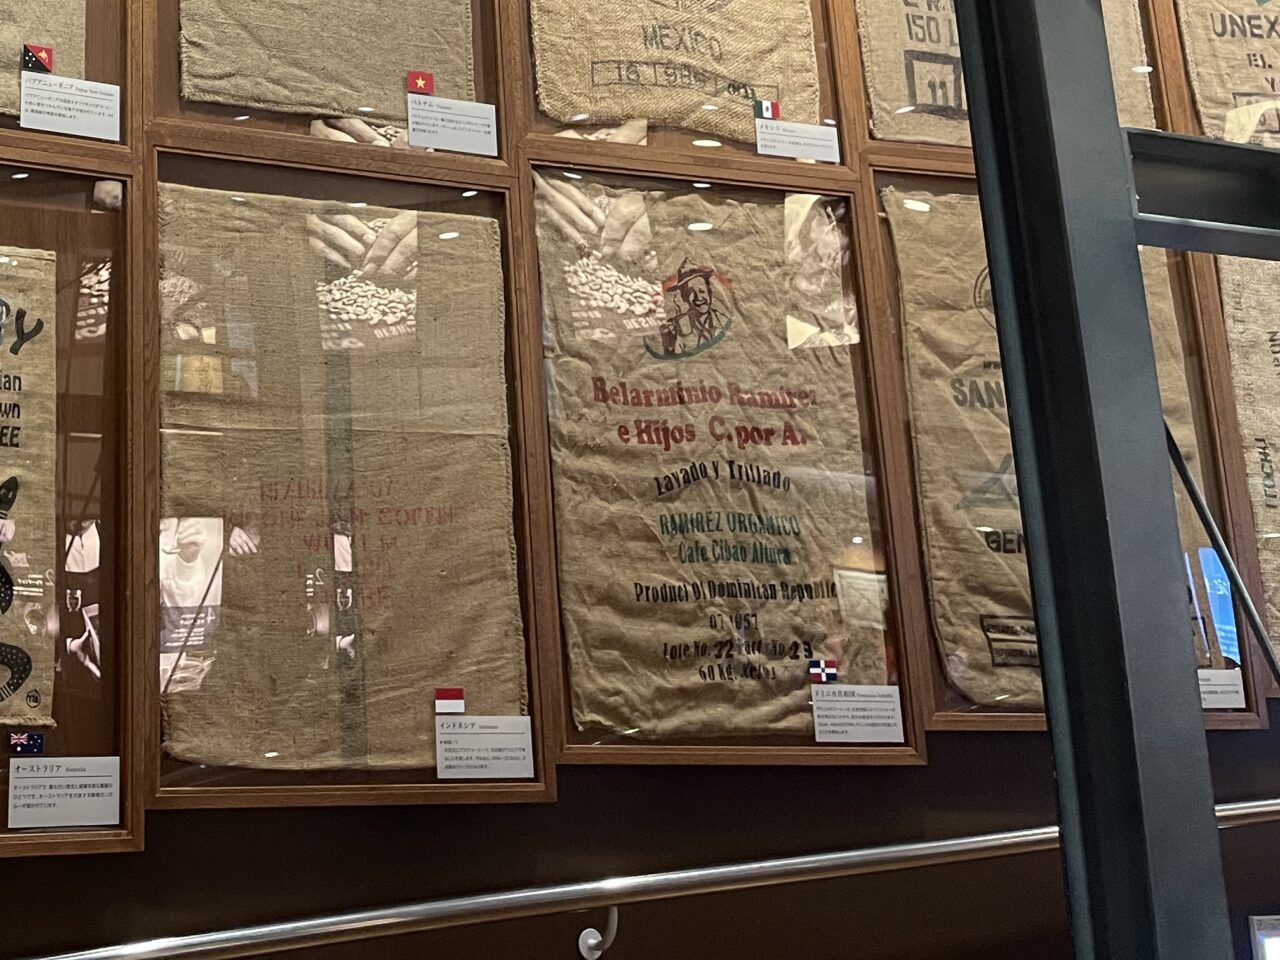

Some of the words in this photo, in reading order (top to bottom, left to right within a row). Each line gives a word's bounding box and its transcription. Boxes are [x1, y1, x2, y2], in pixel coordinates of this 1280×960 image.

[591, 376, 721, 408] Belarminio
[617, 424, 629, 444] e
[634, 418, 697, 452] Hijos
[782, 421, 807, 446] A.
[654, 460, 708, 497] Lavado
[727, 460, 791, 491] Trillado
[660, 511, 723, 535] RAMIREZ
[634, 581, 689, 603] Product
[708, 579, 777, 601] Dominican
[15, 764, 62, 773] オーストラリア
